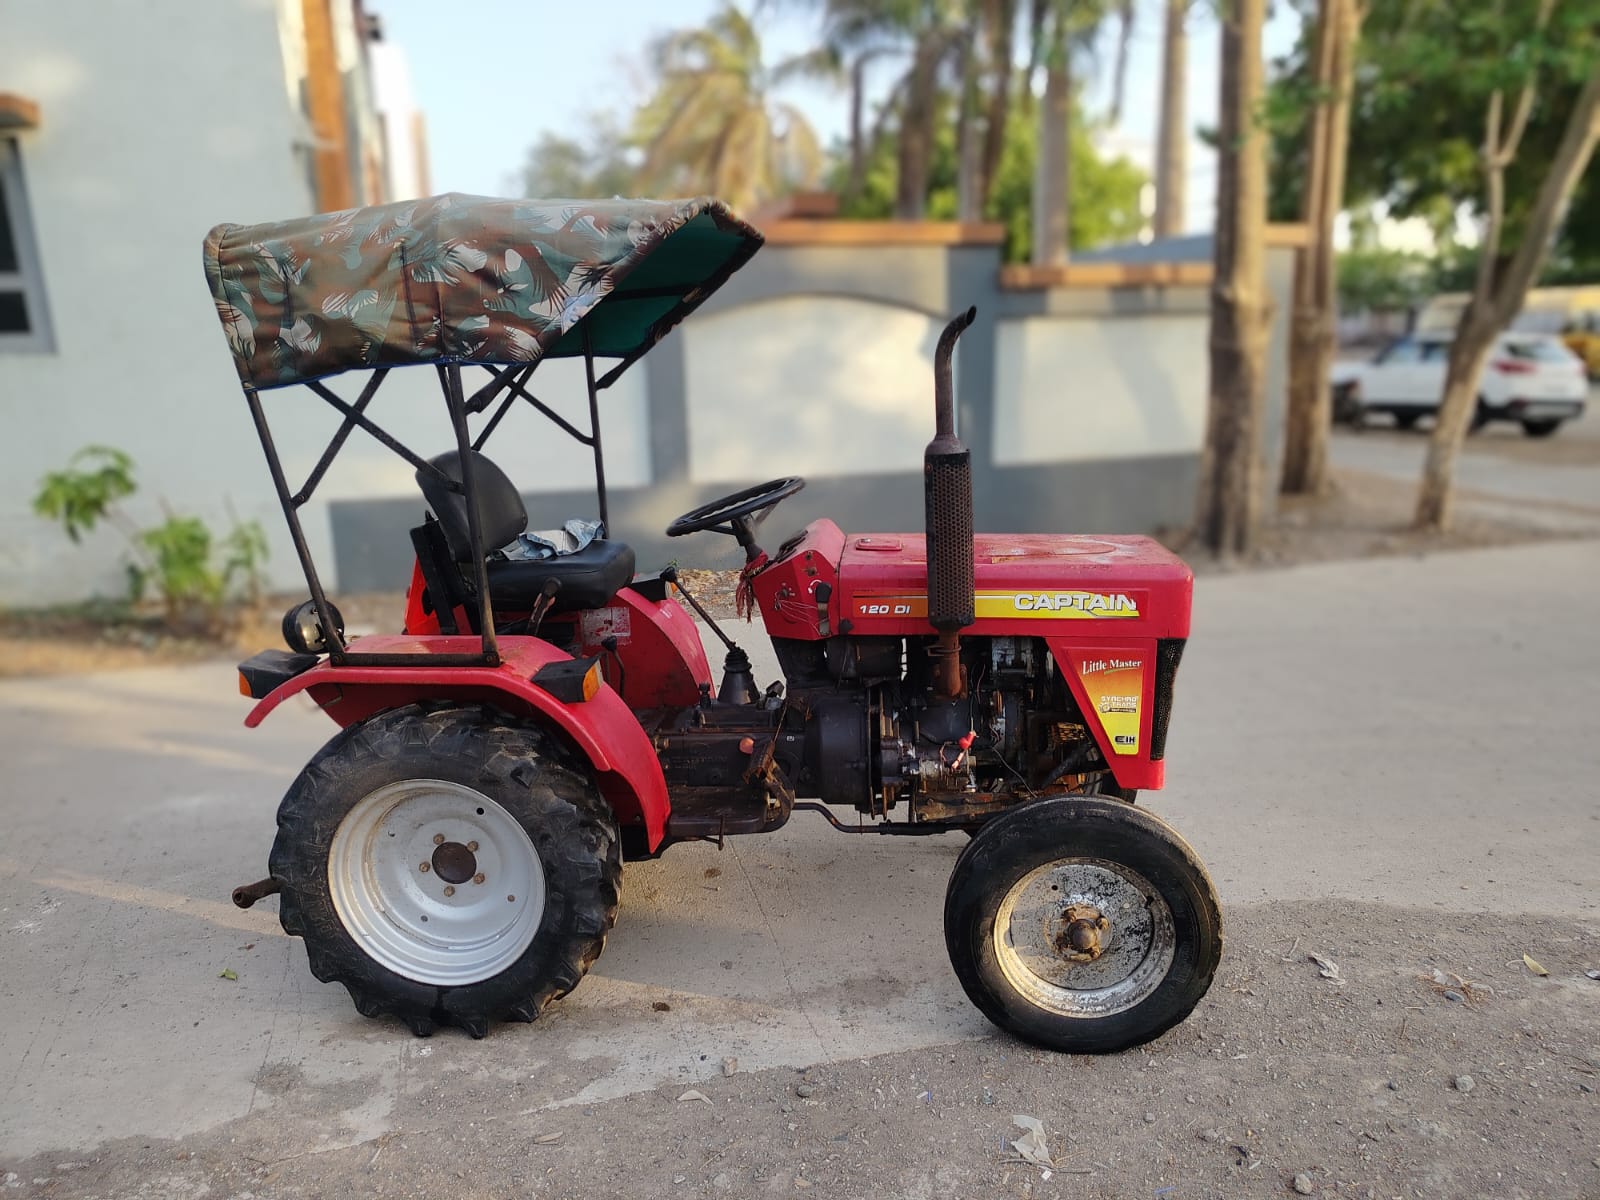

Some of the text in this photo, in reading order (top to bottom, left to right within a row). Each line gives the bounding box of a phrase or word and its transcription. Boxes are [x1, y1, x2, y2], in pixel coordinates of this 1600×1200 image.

[860, 605, 911, 614] 120 DI
[1014, 594, 1137, 610] CAPTAIN
[1082, 659, 1142, 675] Little Master
